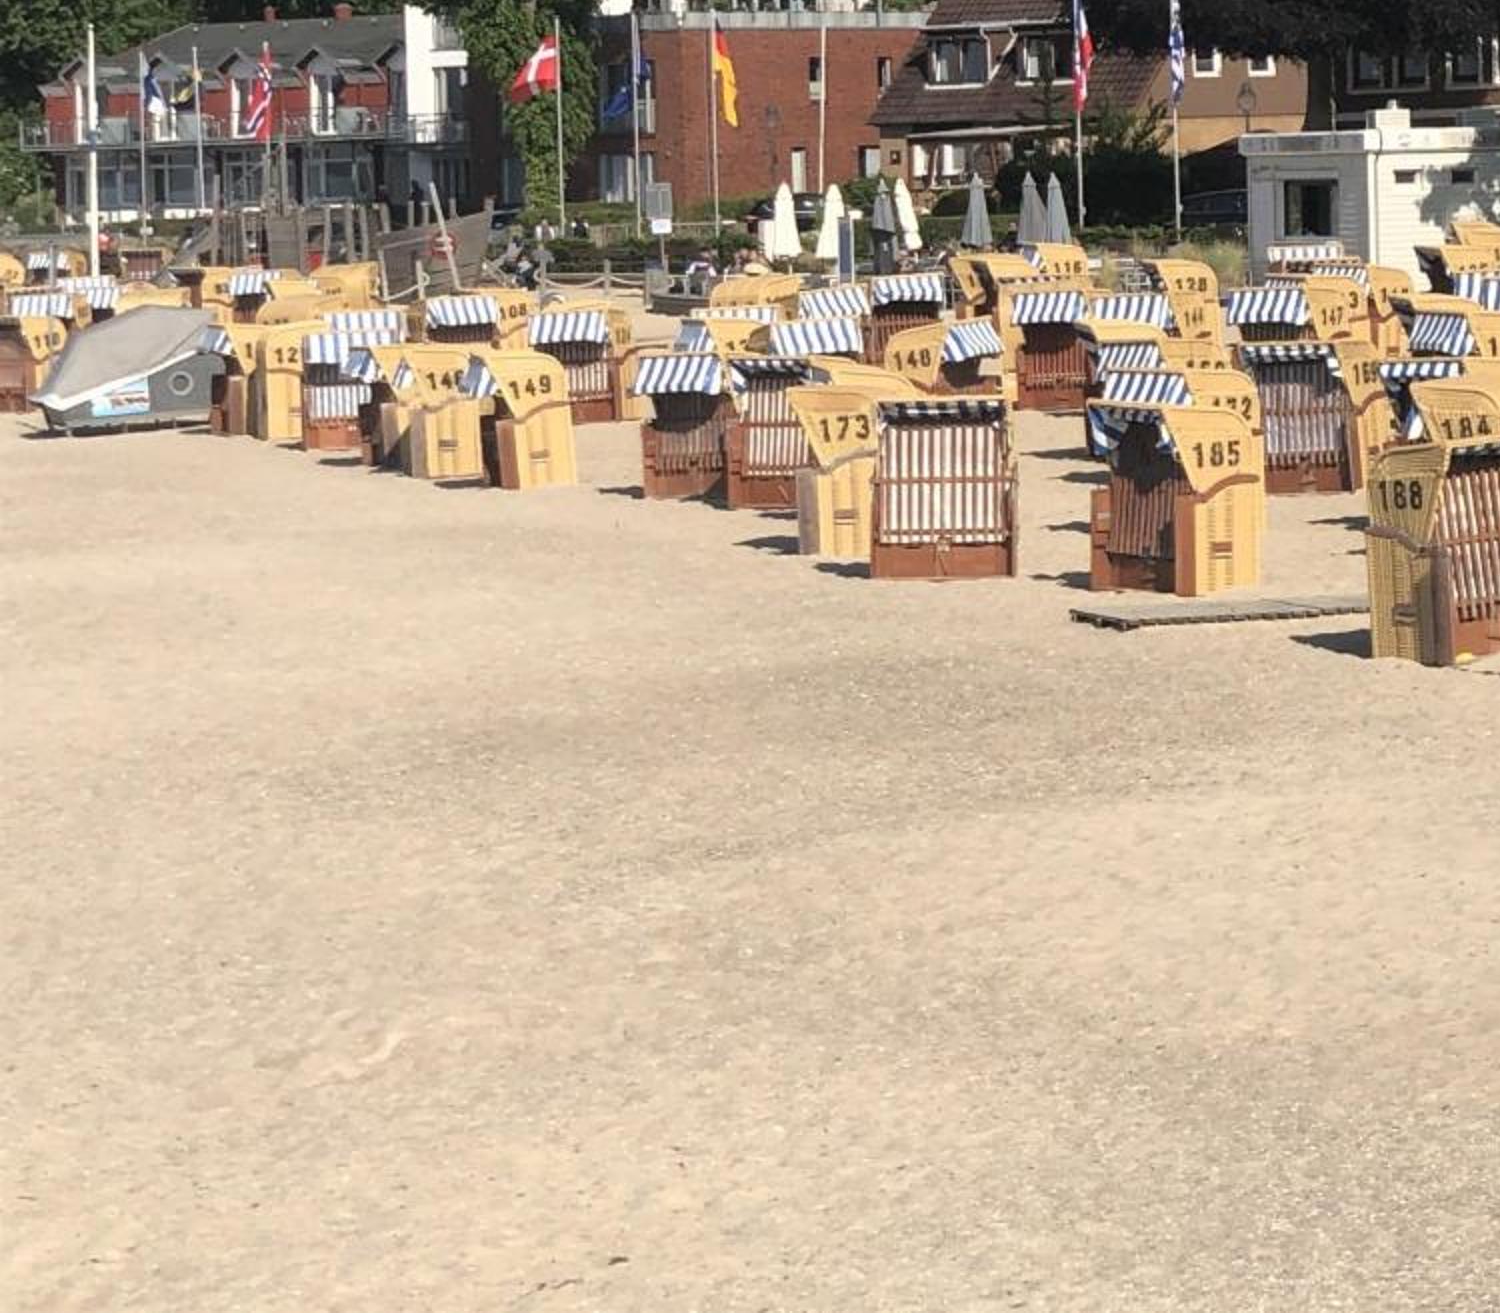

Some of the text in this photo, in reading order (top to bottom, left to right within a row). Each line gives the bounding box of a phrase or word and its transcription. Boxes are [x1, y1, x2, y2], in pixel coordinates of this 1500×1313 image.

[508, 375, 551, 400] 149
[820, 415, 870, 443] 173
[1441, 415, 1492, 439] 184
[1193, 441, 1241, 468] 185
[1378, 480, 1423, 511] 188
